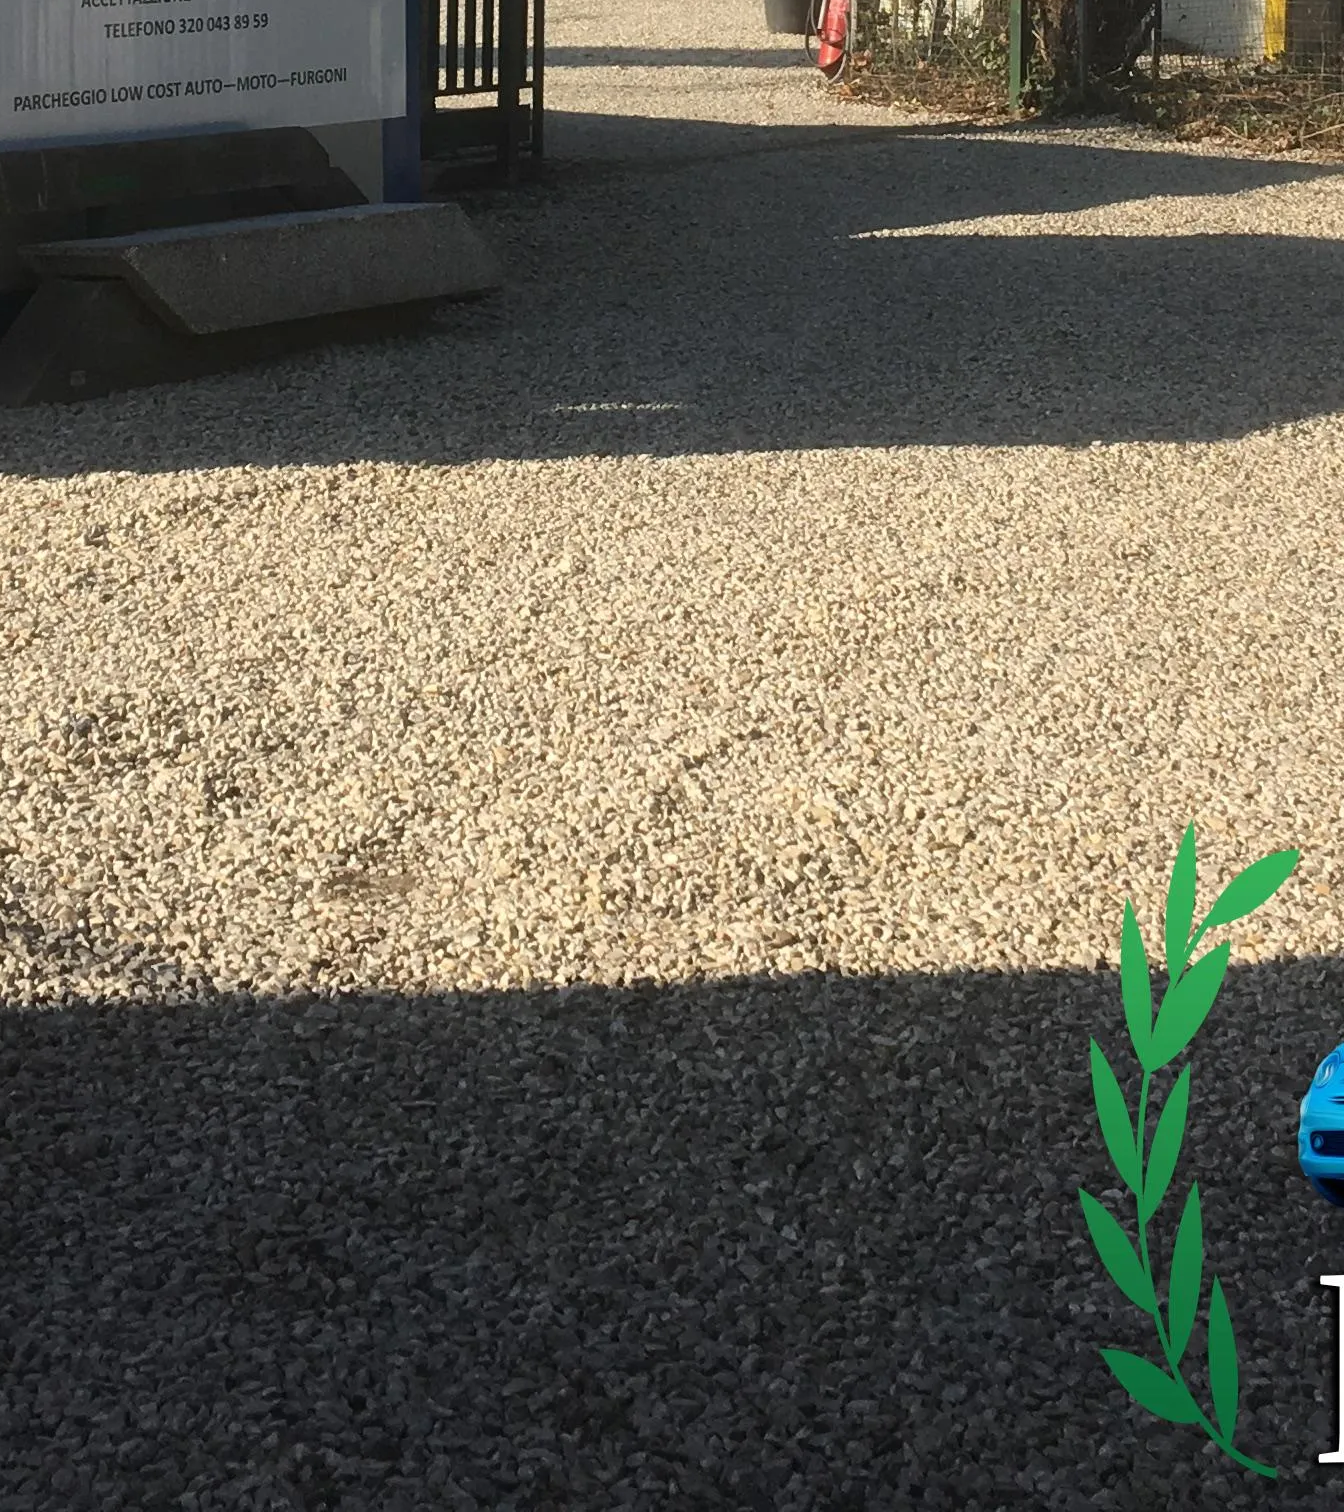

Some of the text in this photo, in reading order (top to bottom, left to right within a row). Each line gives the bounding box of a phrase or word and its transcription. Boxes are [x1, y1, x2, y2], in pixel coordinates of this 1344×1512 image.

[104, 13, 269, 39] TELEFONO 320 043 89 59
[13, 87, 107, 113] PARCHEGGIO
[111, 85, 144, 103] LOW
[147, 82, 182, 100] COST
